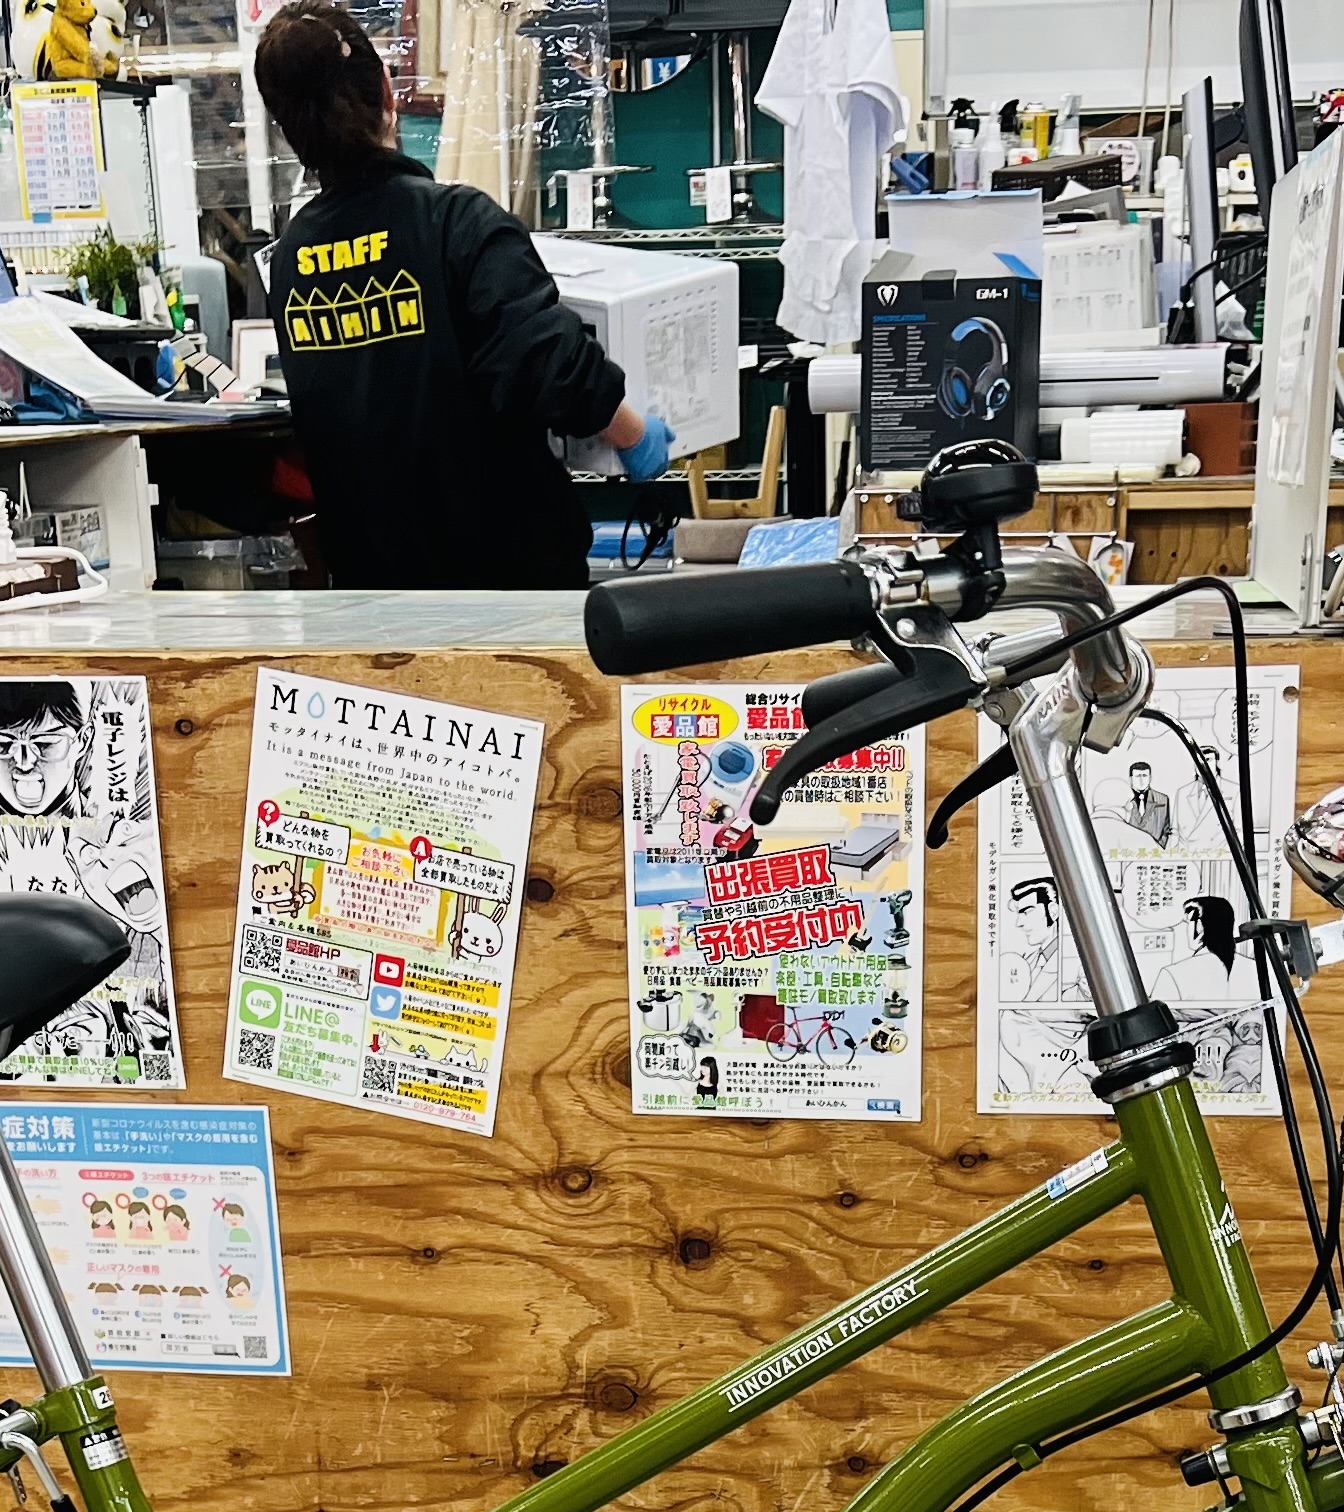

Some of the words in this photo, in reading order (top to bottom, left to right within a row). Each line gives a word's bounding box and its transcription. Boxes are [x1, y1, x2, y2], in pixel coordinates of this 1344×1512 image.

[297, 231, 388, 275] STAFF
[292, 299, 418, 342] AIHIN
[659, 697, 712, 711] リサイクル
[745, 693, 802, 706] 総合リサイ
[652, 715, 719, 738] 愛品館
[102, 711, 129, 802] 電子レンジは
[268, 721, 522, 784] モッタイナイは、世界中のアイコトバ。
[266, 740, 277, 752] It
[282, 742, 292, 753] is
[309, 750, 362, 769] message
[366, 760, 395, 776] from
[400, 767, 434, 787] Japan
[438, 774, 452, 787] to
[456, 779, 475, 792] the
[283, 820, 330, 841] どんな物を
[362, 846, 403, 864] お気軽に
[414, 840, 427, 857] A
[428, 854, 506, 881] お店で売っている物は
[707, 848, 834, 902] 出張買取
[696, 901, 864, 964] 予約受付中
[285, 938, 341, 960] 愛品館HP
[1009, 967, 1019, 985] はい
[250, 997, 272, 1010] LINE
[284, 1002, 340, 1028] LINE@
[282, 1021, 358, 1048] 友だち募集中。
[992, 1092, 1102, 1104] 電動ガンやガスガンよりも
[1037, 1081, 1091, 1092] マルシン・マル
[725, 1333, 834, 1407] INNOVATION
[838, 1279, 919, 1339] FACTORY
